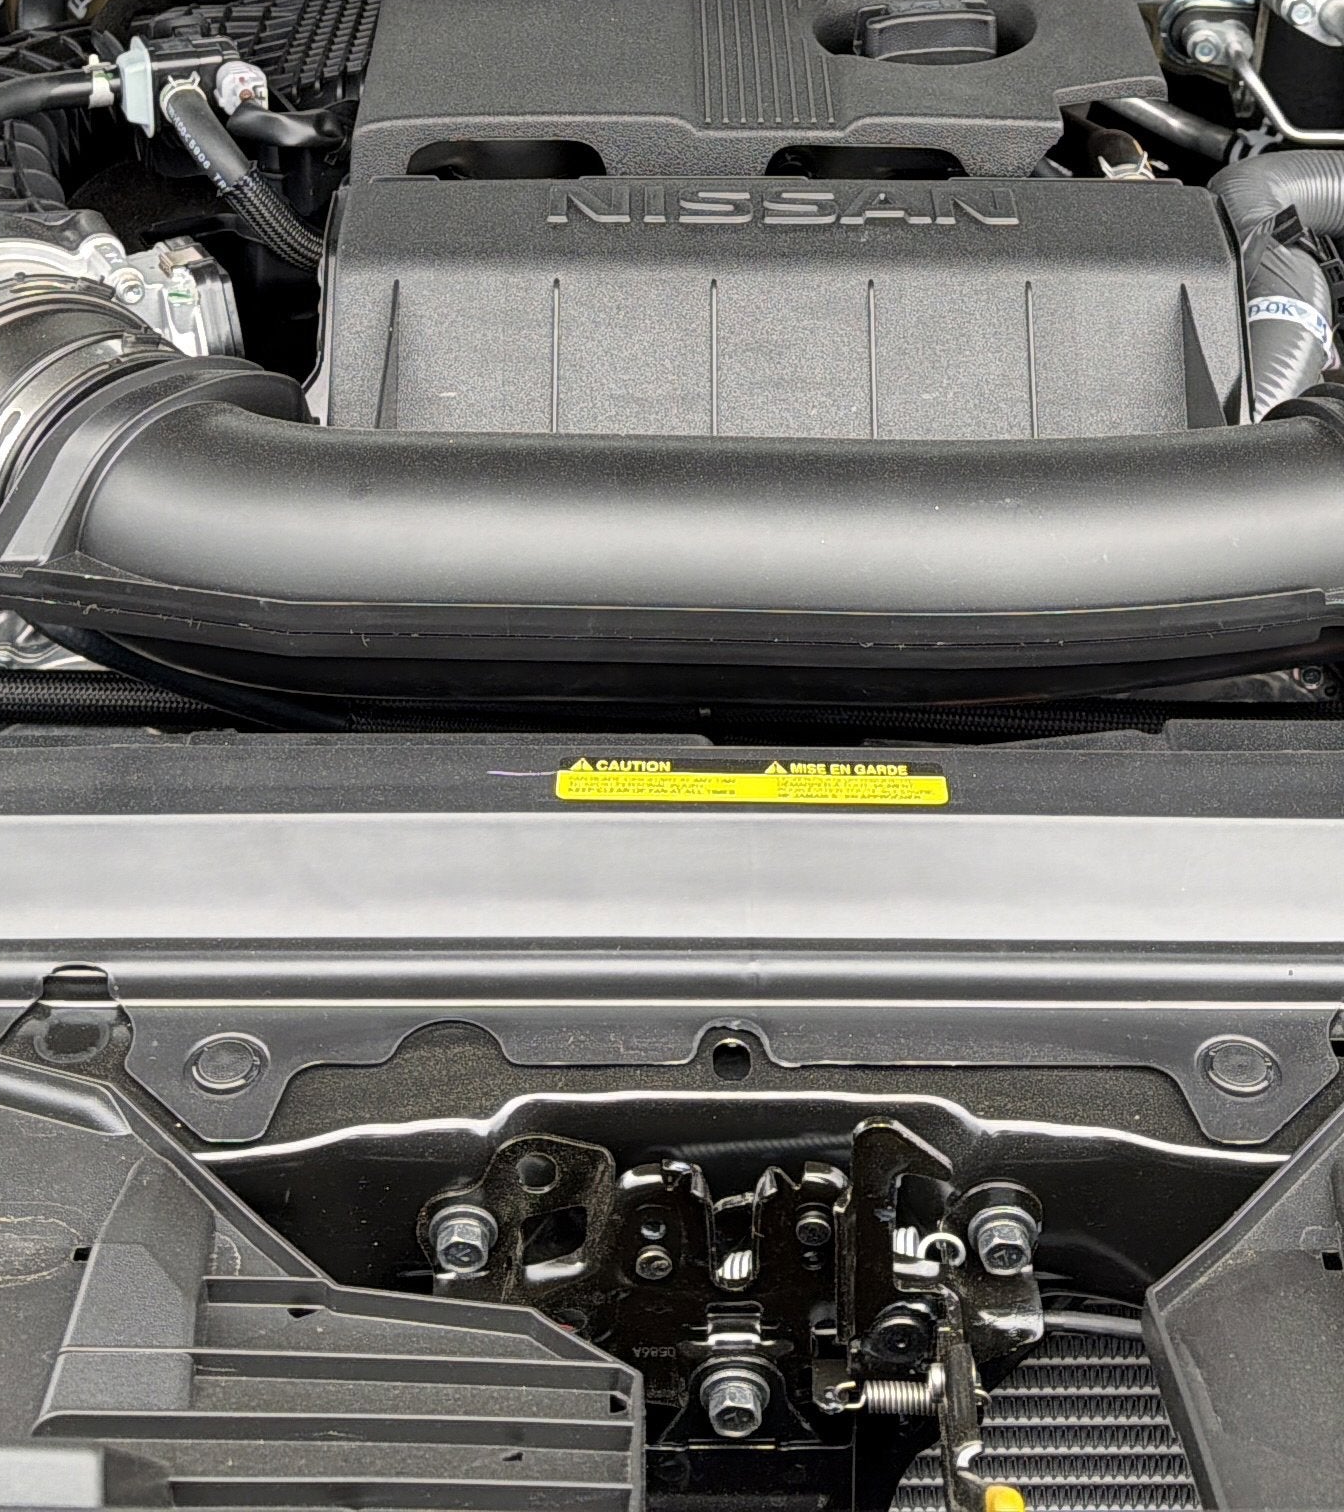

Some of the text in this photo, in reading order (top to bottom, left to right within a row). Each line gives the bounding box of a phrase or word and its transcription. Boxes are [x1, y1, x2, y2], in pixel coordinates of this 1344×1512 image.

[546, 186, 1020, 226] NISSAN
[595, 760, 671, 772] CAUTION
[790, 763, 908, 776] MISE EN GARDE
